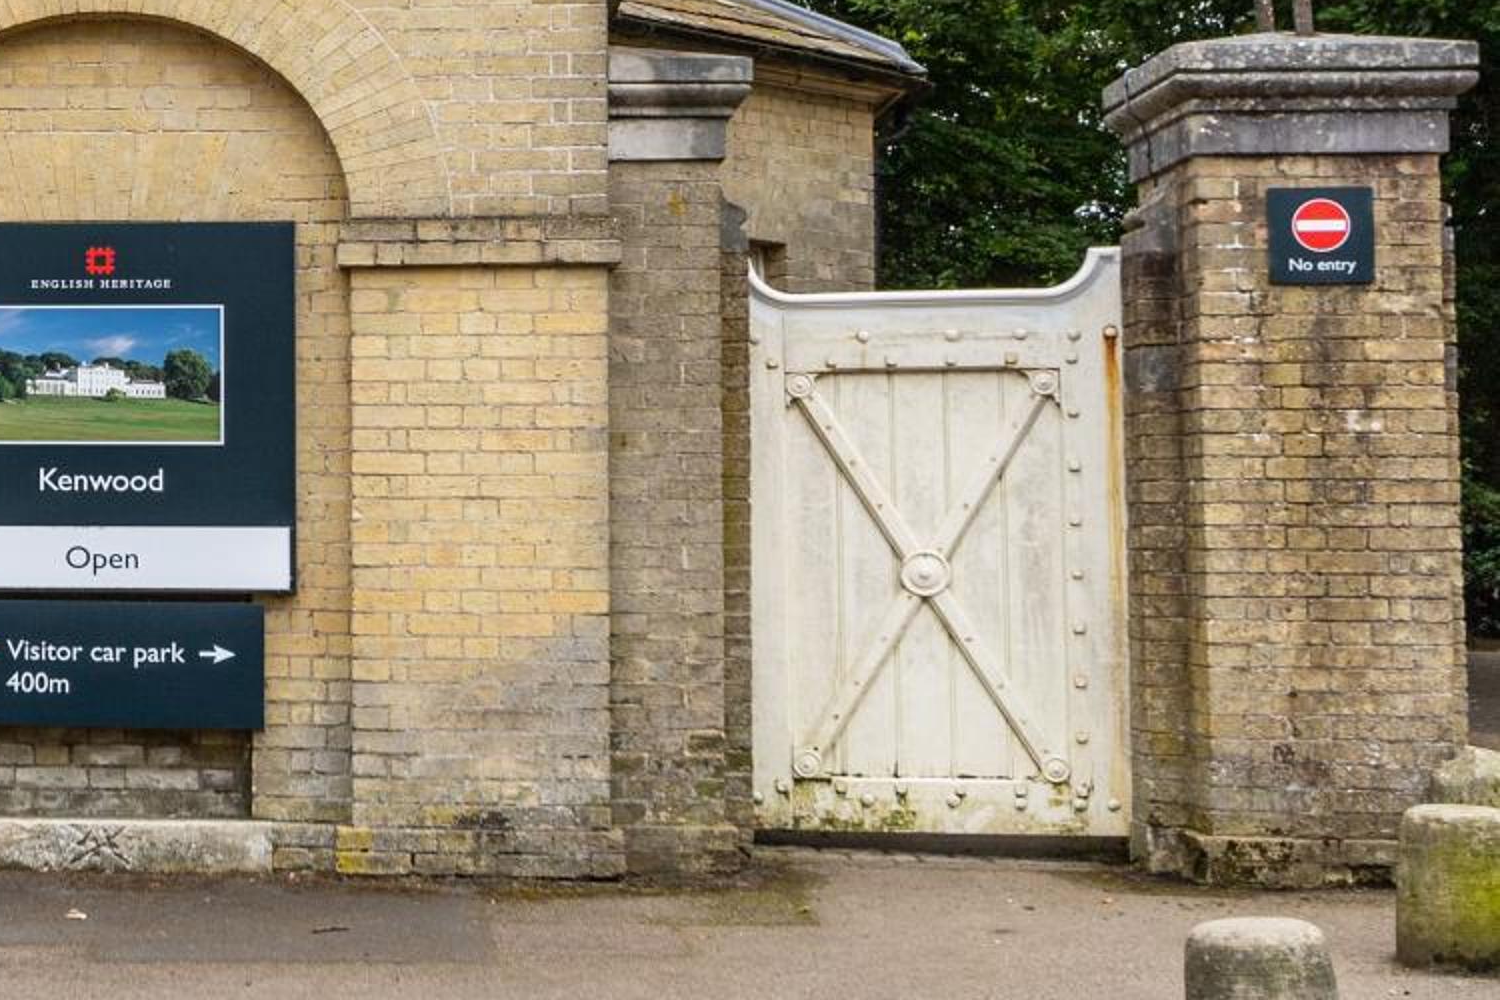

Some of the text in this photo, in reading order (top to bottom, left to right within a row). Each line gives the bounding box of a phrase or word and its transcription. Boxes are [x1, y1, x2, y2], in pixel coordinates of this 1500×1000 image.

[1288, 258, 1357, 275] No entry
[31, 279, 171, 289] ENGLISH HERITAGE
[39, 467, 164, 492] Kenwood
[65, 546, 140, 575] Open
[6, 638, 83, 661] Visitor
[90, 646, 127, 662] car
[133, 642, 186, 668] park
[5, 671, 70, 693] 400m
